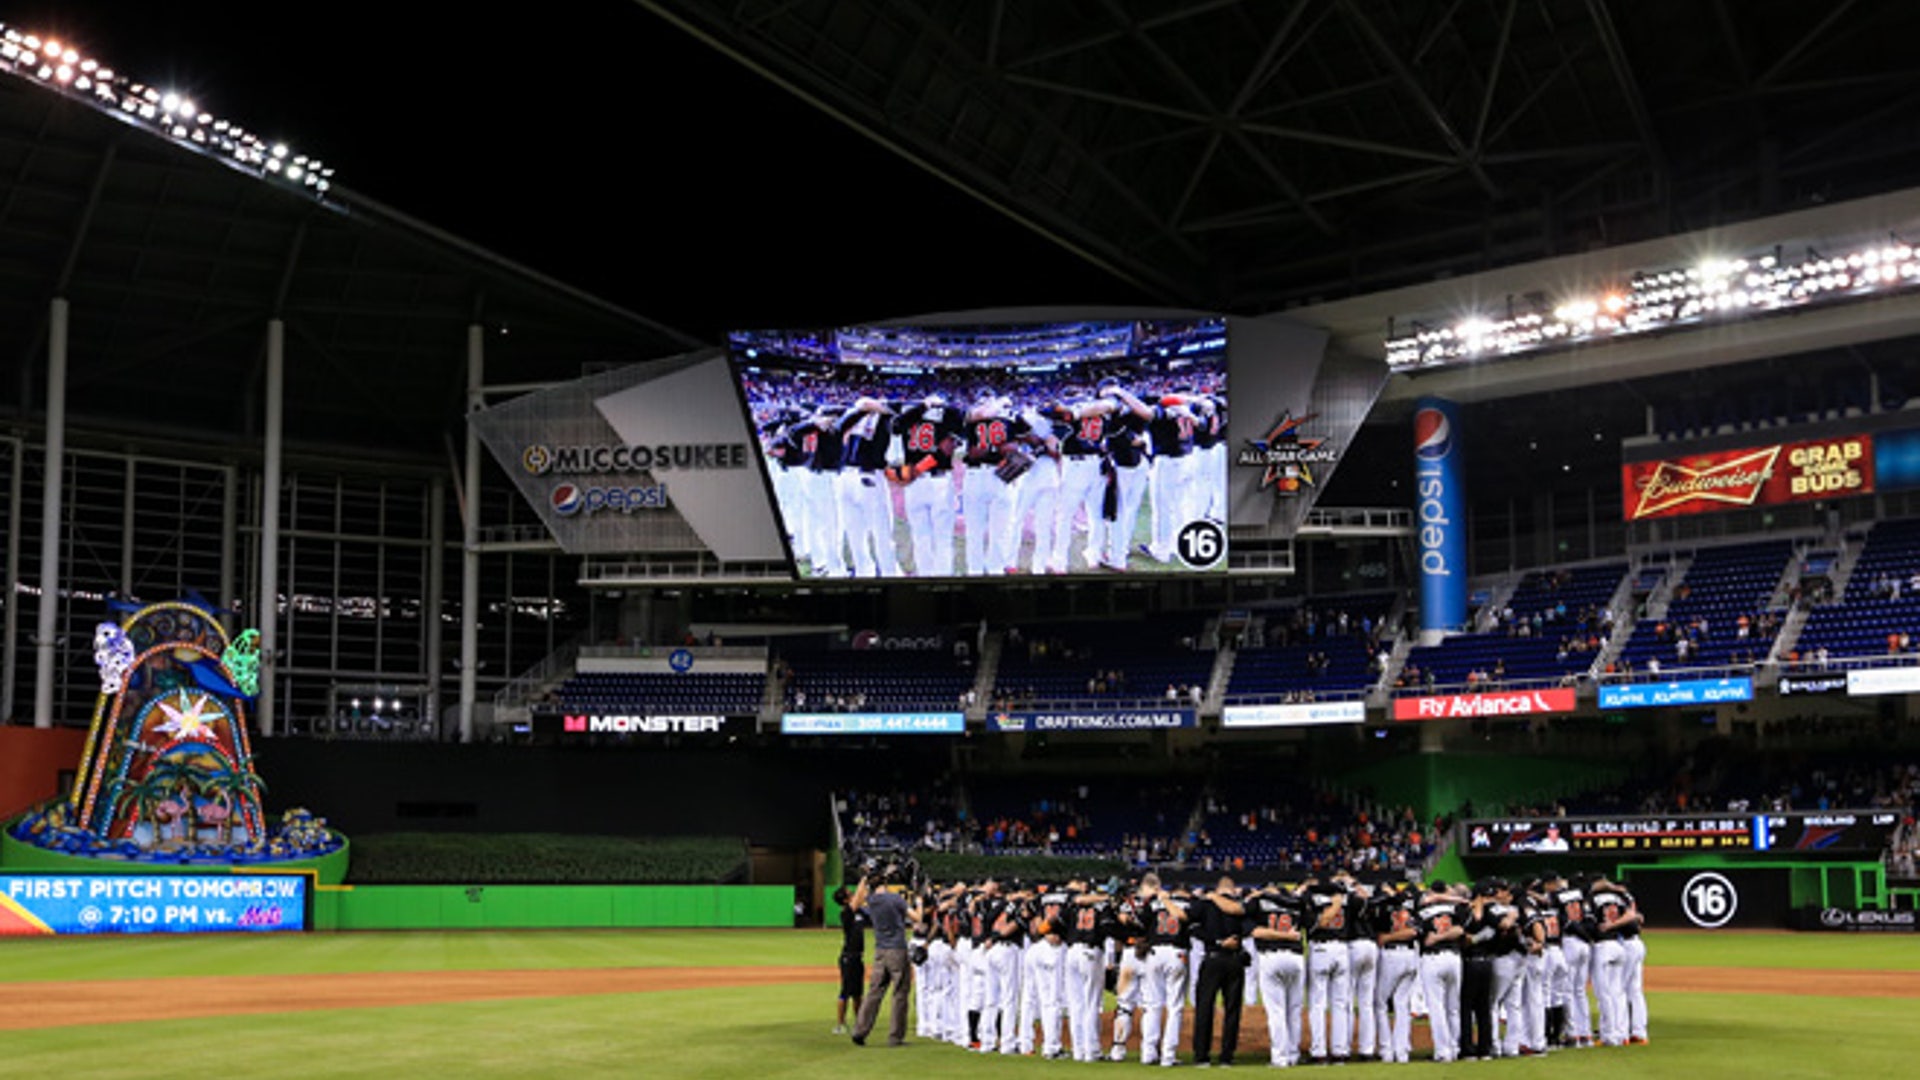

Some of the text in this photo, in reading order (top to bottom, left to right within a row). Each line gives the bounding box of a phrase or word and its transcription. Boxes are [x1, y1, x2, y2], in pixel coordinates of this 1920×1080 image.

[907, 423, 935, 450] 16
[976, 421, 1008, 450] 16
[554, 445, 747, 471] MICCOSUKEE
[1297, 448, 1337, 462] GAME
[1789, 442, 1862, 466] GRAB
[1636, 467, 1773, 498] Budweiser
[1791, 471, 1861, 493] BUDS
[584, 484, 667, 513] pepsi
[1417, 465, 1451, 576] pepsi
[1183, 529, 1217, 557] 16
[1419, 695, 1531, 717] Fly Avianca
[590, 716, 720, 732] MONSTER
[9, 880, 297, 898] FIRST PITCH TOMORROW
[1690, 884, 1727, 916] 16
[79, 906, 102, 927] @
[110, 905, 157, 923] 7:10
[165, 905, 198, 923] PM
[204, 908, 233, 923] vs.
[1846, 910, 1915, 923] LEXUS
